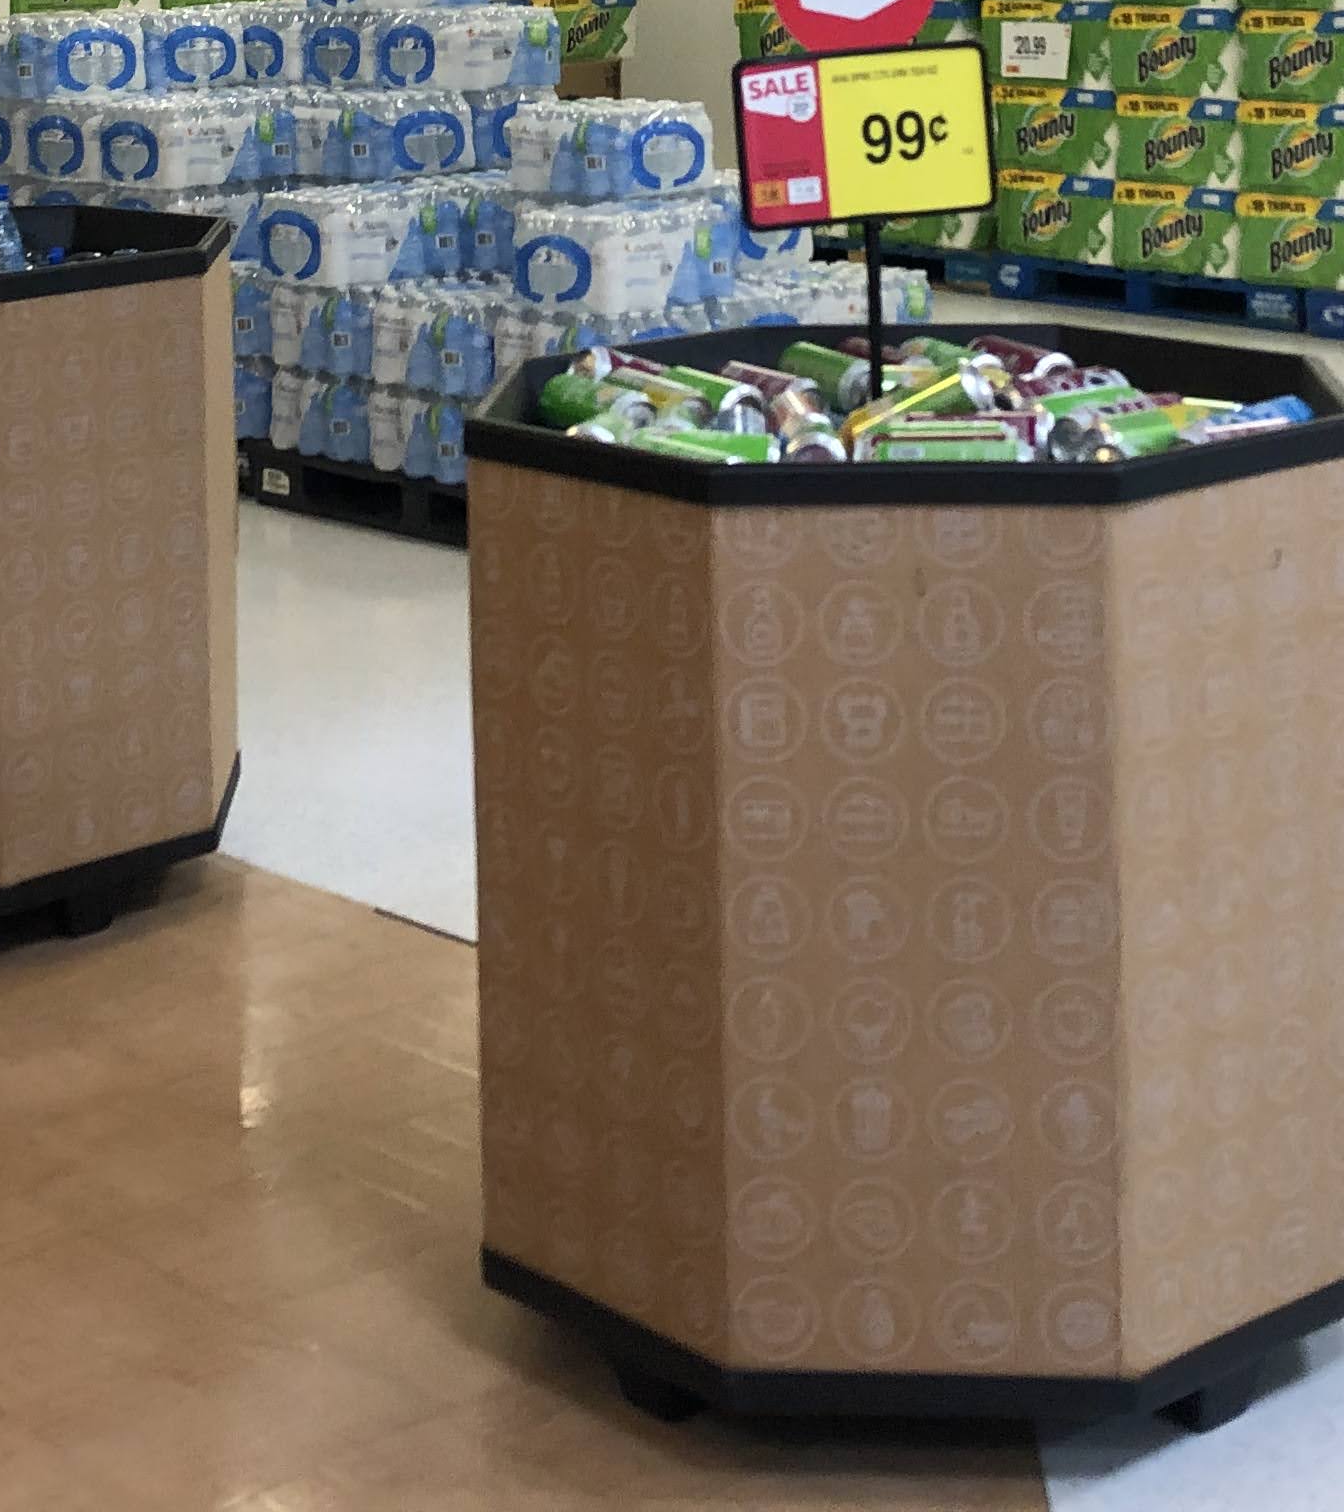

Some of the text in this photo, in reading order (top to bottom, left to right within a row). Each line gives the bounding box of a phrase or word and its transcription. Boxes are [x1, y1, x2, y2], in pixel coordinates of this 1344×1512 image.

[1135, 12, 1171, 24] TRIPLES
[1267, 16, 1306, 28] TRIPLES
[1137, 36, 1197, 83] Bounty
[1268, 38, 1334, 90] Bounty
[747, 72, 810, 101] SALE
[1143, 100, 1180, 112] TRIPLES
[1268, 107, 1307, 120] TRIPLES
[1016, 112, 1075, 156] Bounty
[1144, 125, 1206, 171] Bounty
[1270, 131, 1334, 181] Bounty
[1138, 189, 1176, 201] TRIPLES
[1268, 200, 1306, 213] TRIPLES
[1141, 213, 1204, 259] Bounty
[1269, 226, 1333, 274] Bounty
